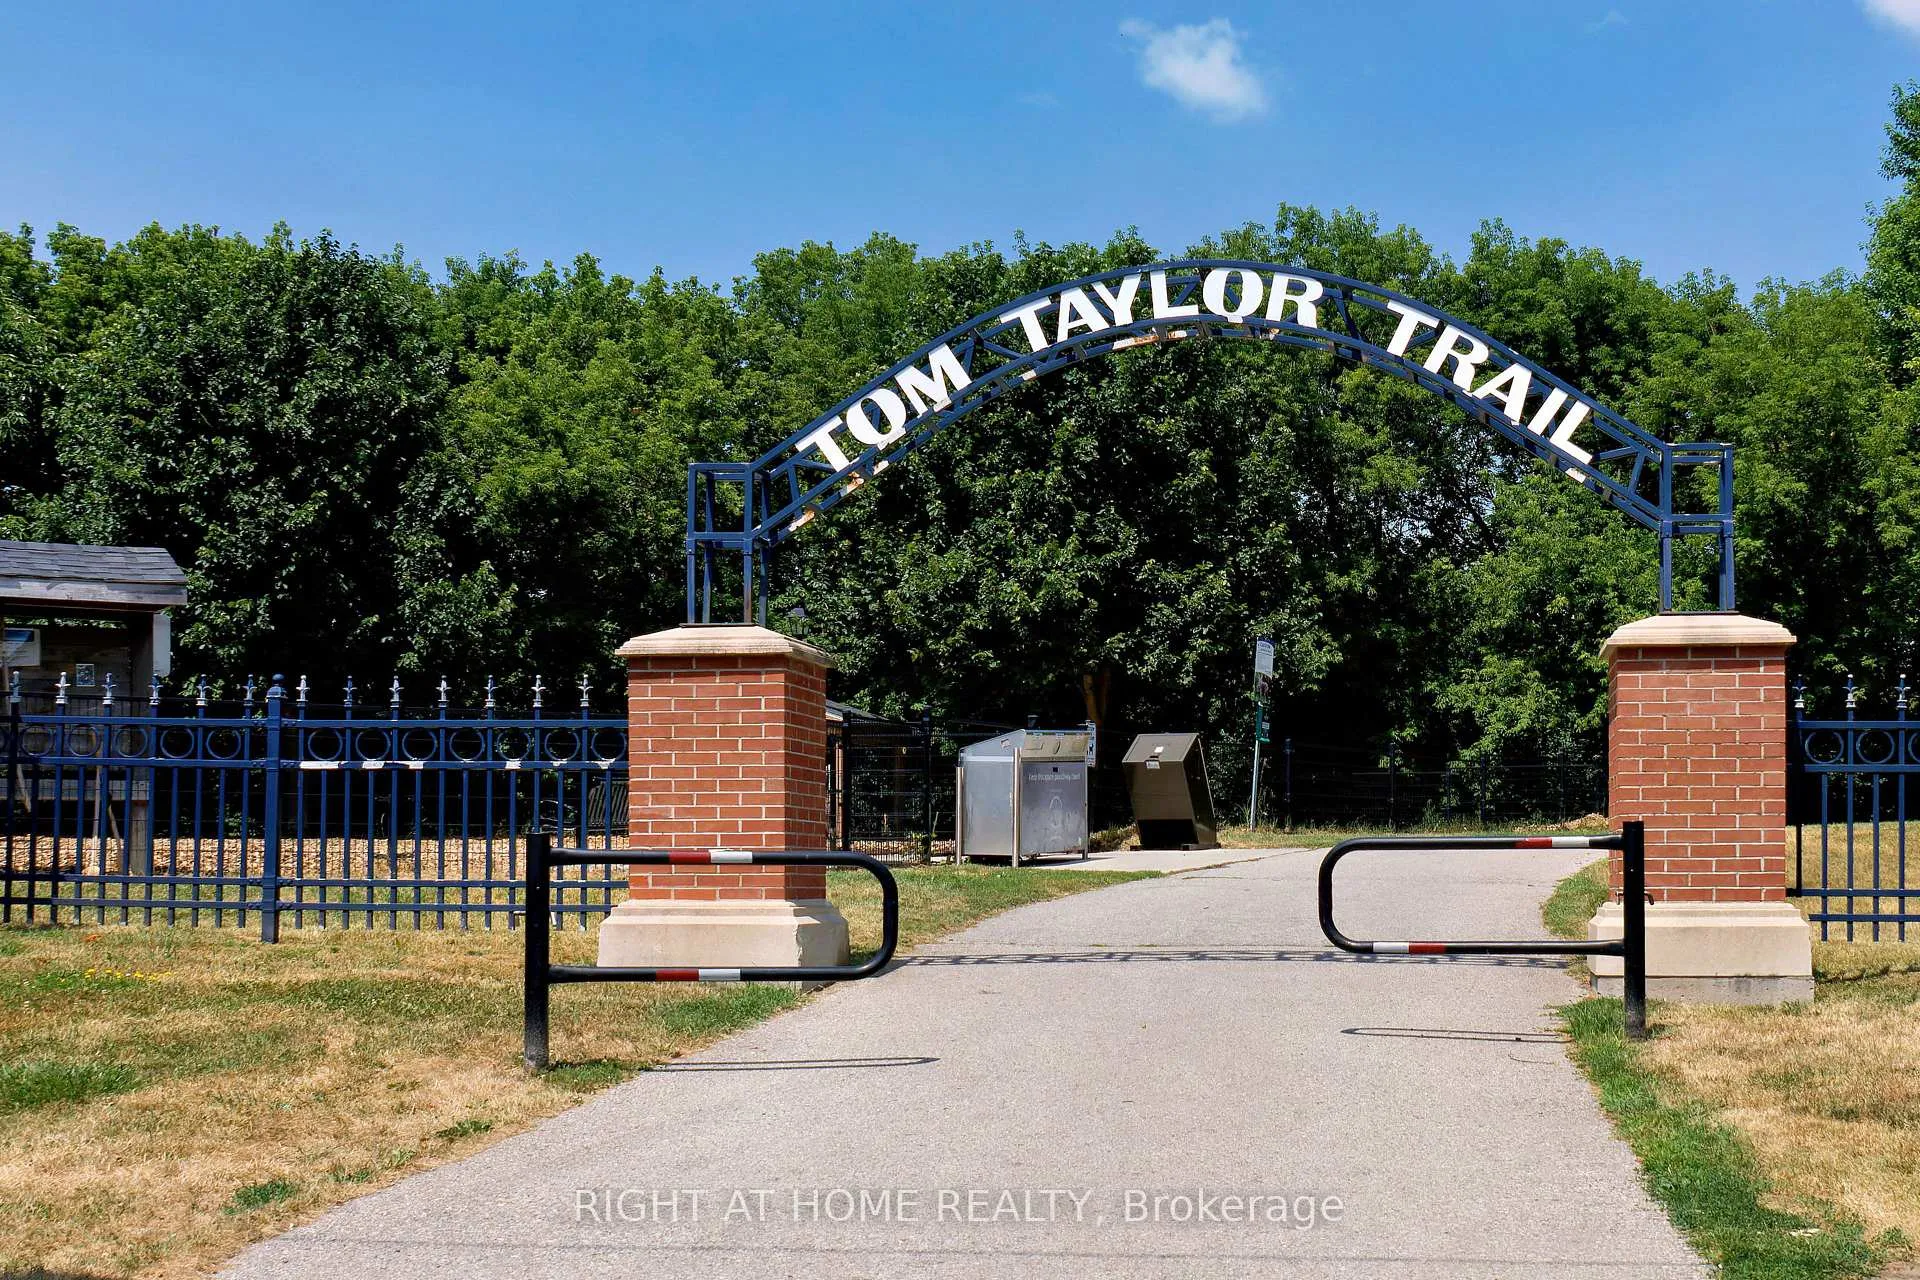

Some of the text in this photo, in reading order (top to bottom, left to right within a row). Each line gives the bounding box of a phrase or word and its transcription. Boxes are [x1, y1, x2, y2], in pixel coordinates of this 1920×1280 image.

[795, 267, 1593, 472] TOM TAYLOR TRAIL
